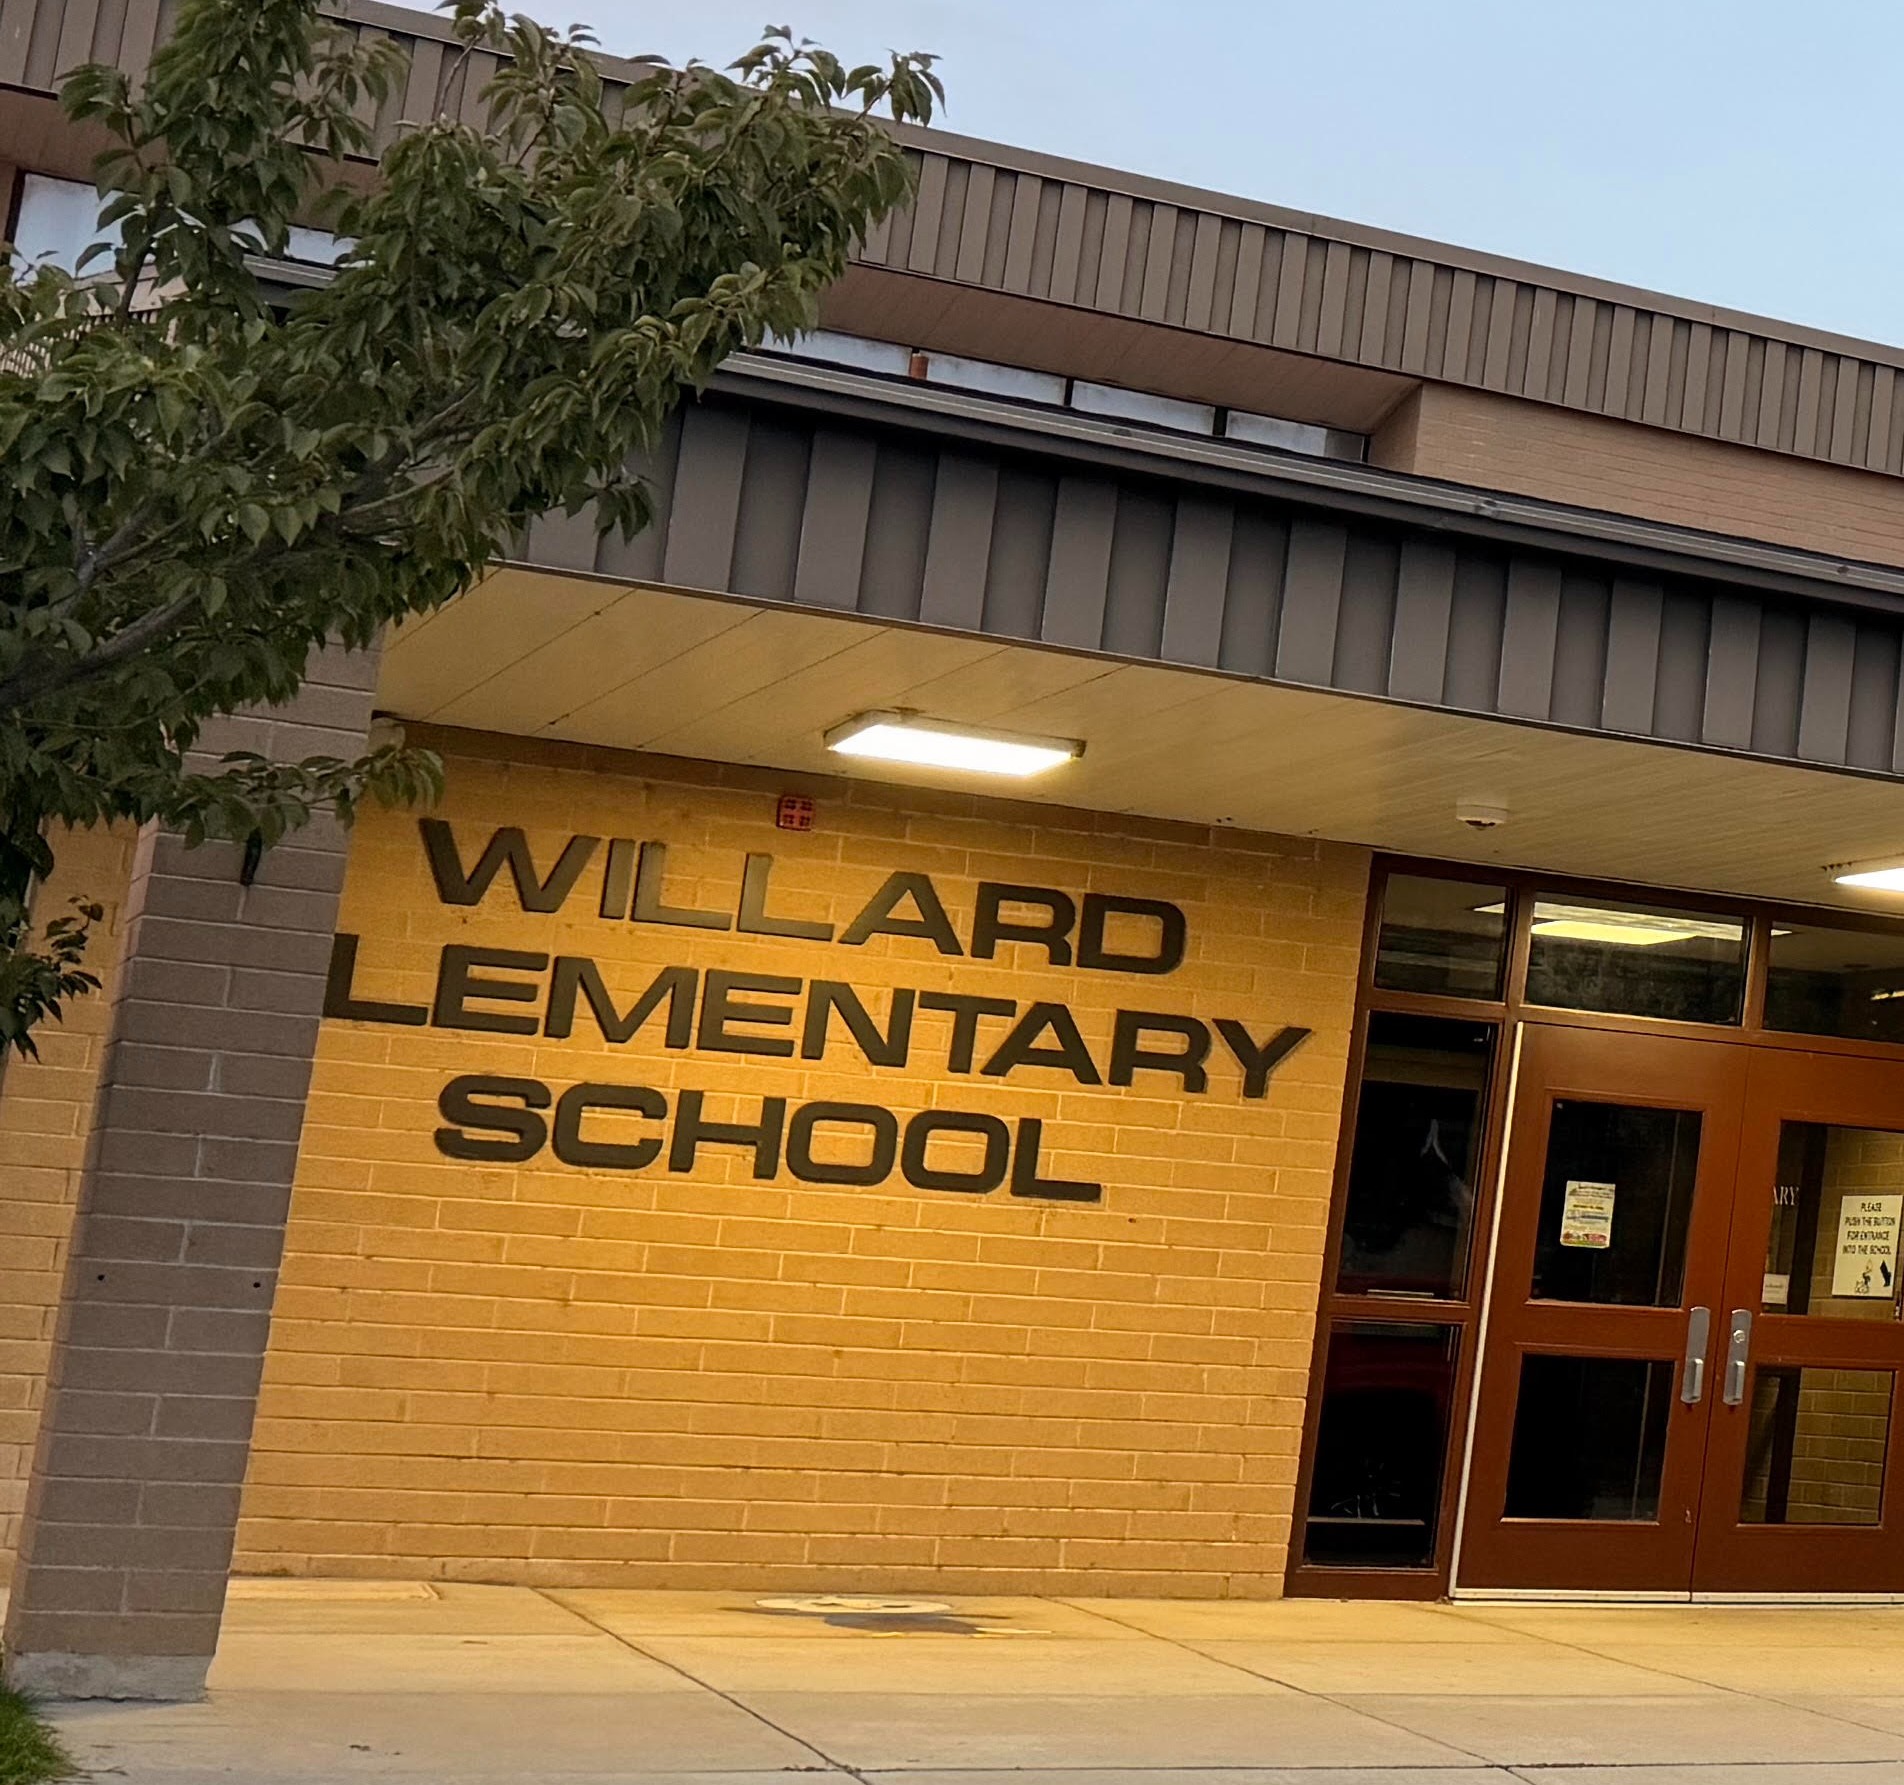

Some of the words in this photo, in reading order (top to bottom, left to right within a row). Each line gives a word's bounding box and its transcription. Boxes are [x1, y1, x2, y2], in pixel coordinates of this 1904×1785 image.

[418, 817, 1187, 976] WILLARD
[432, 1074, 1103, 1203] SCHOOL
[1860, 1202, 1882, 1212] PLEASE
[1845, 1216, 1860, 1226] PUSH
[1862, 1216, 1872, 1226] THE
[1873, 1216, 1896, 1227] BUTTON
[1847, 1230, 1859, 1240] FOR
[1860, 1230, 1890, 1241] ENTRANCE
[1858, 1245, 1869, 1255] THE
[1870, 1245, 1892, 1255] SCHOOL
